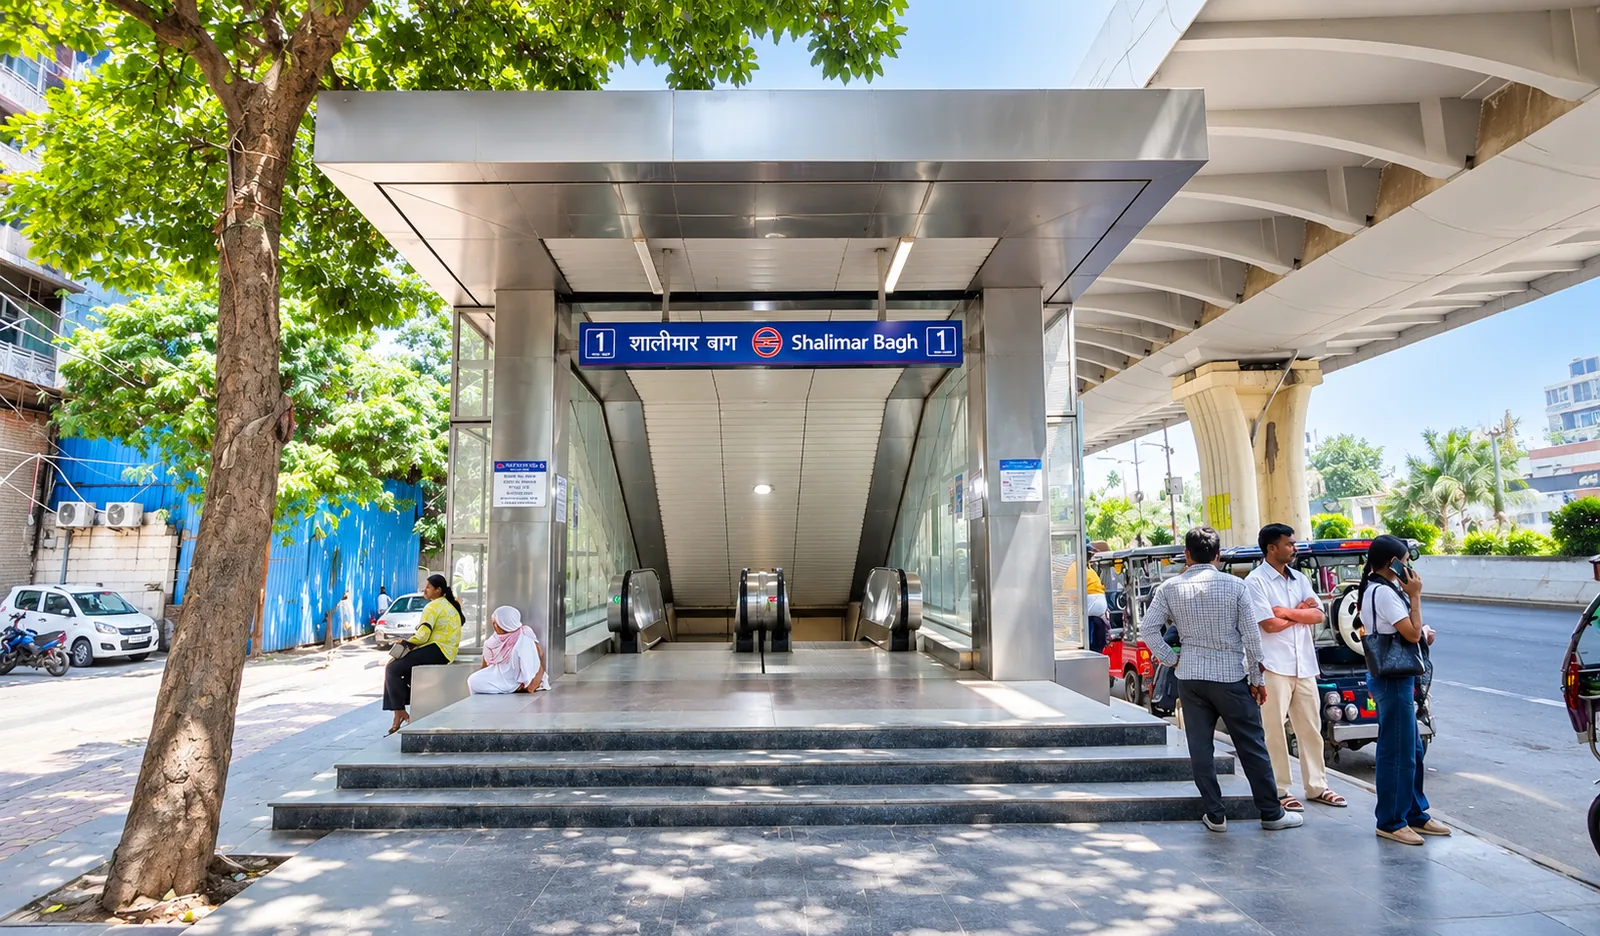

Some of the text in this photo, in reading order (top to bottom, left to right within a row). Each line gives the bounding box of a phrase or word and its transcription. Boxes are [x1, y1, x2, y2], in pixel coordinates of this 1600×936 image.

[595, 331, 604, 352] 1
[629, 330, 738, 352] शालीमार बाग
[791, 333, 918, 354] Shalimar Bagh
[936, 329, 945, 351] 1
